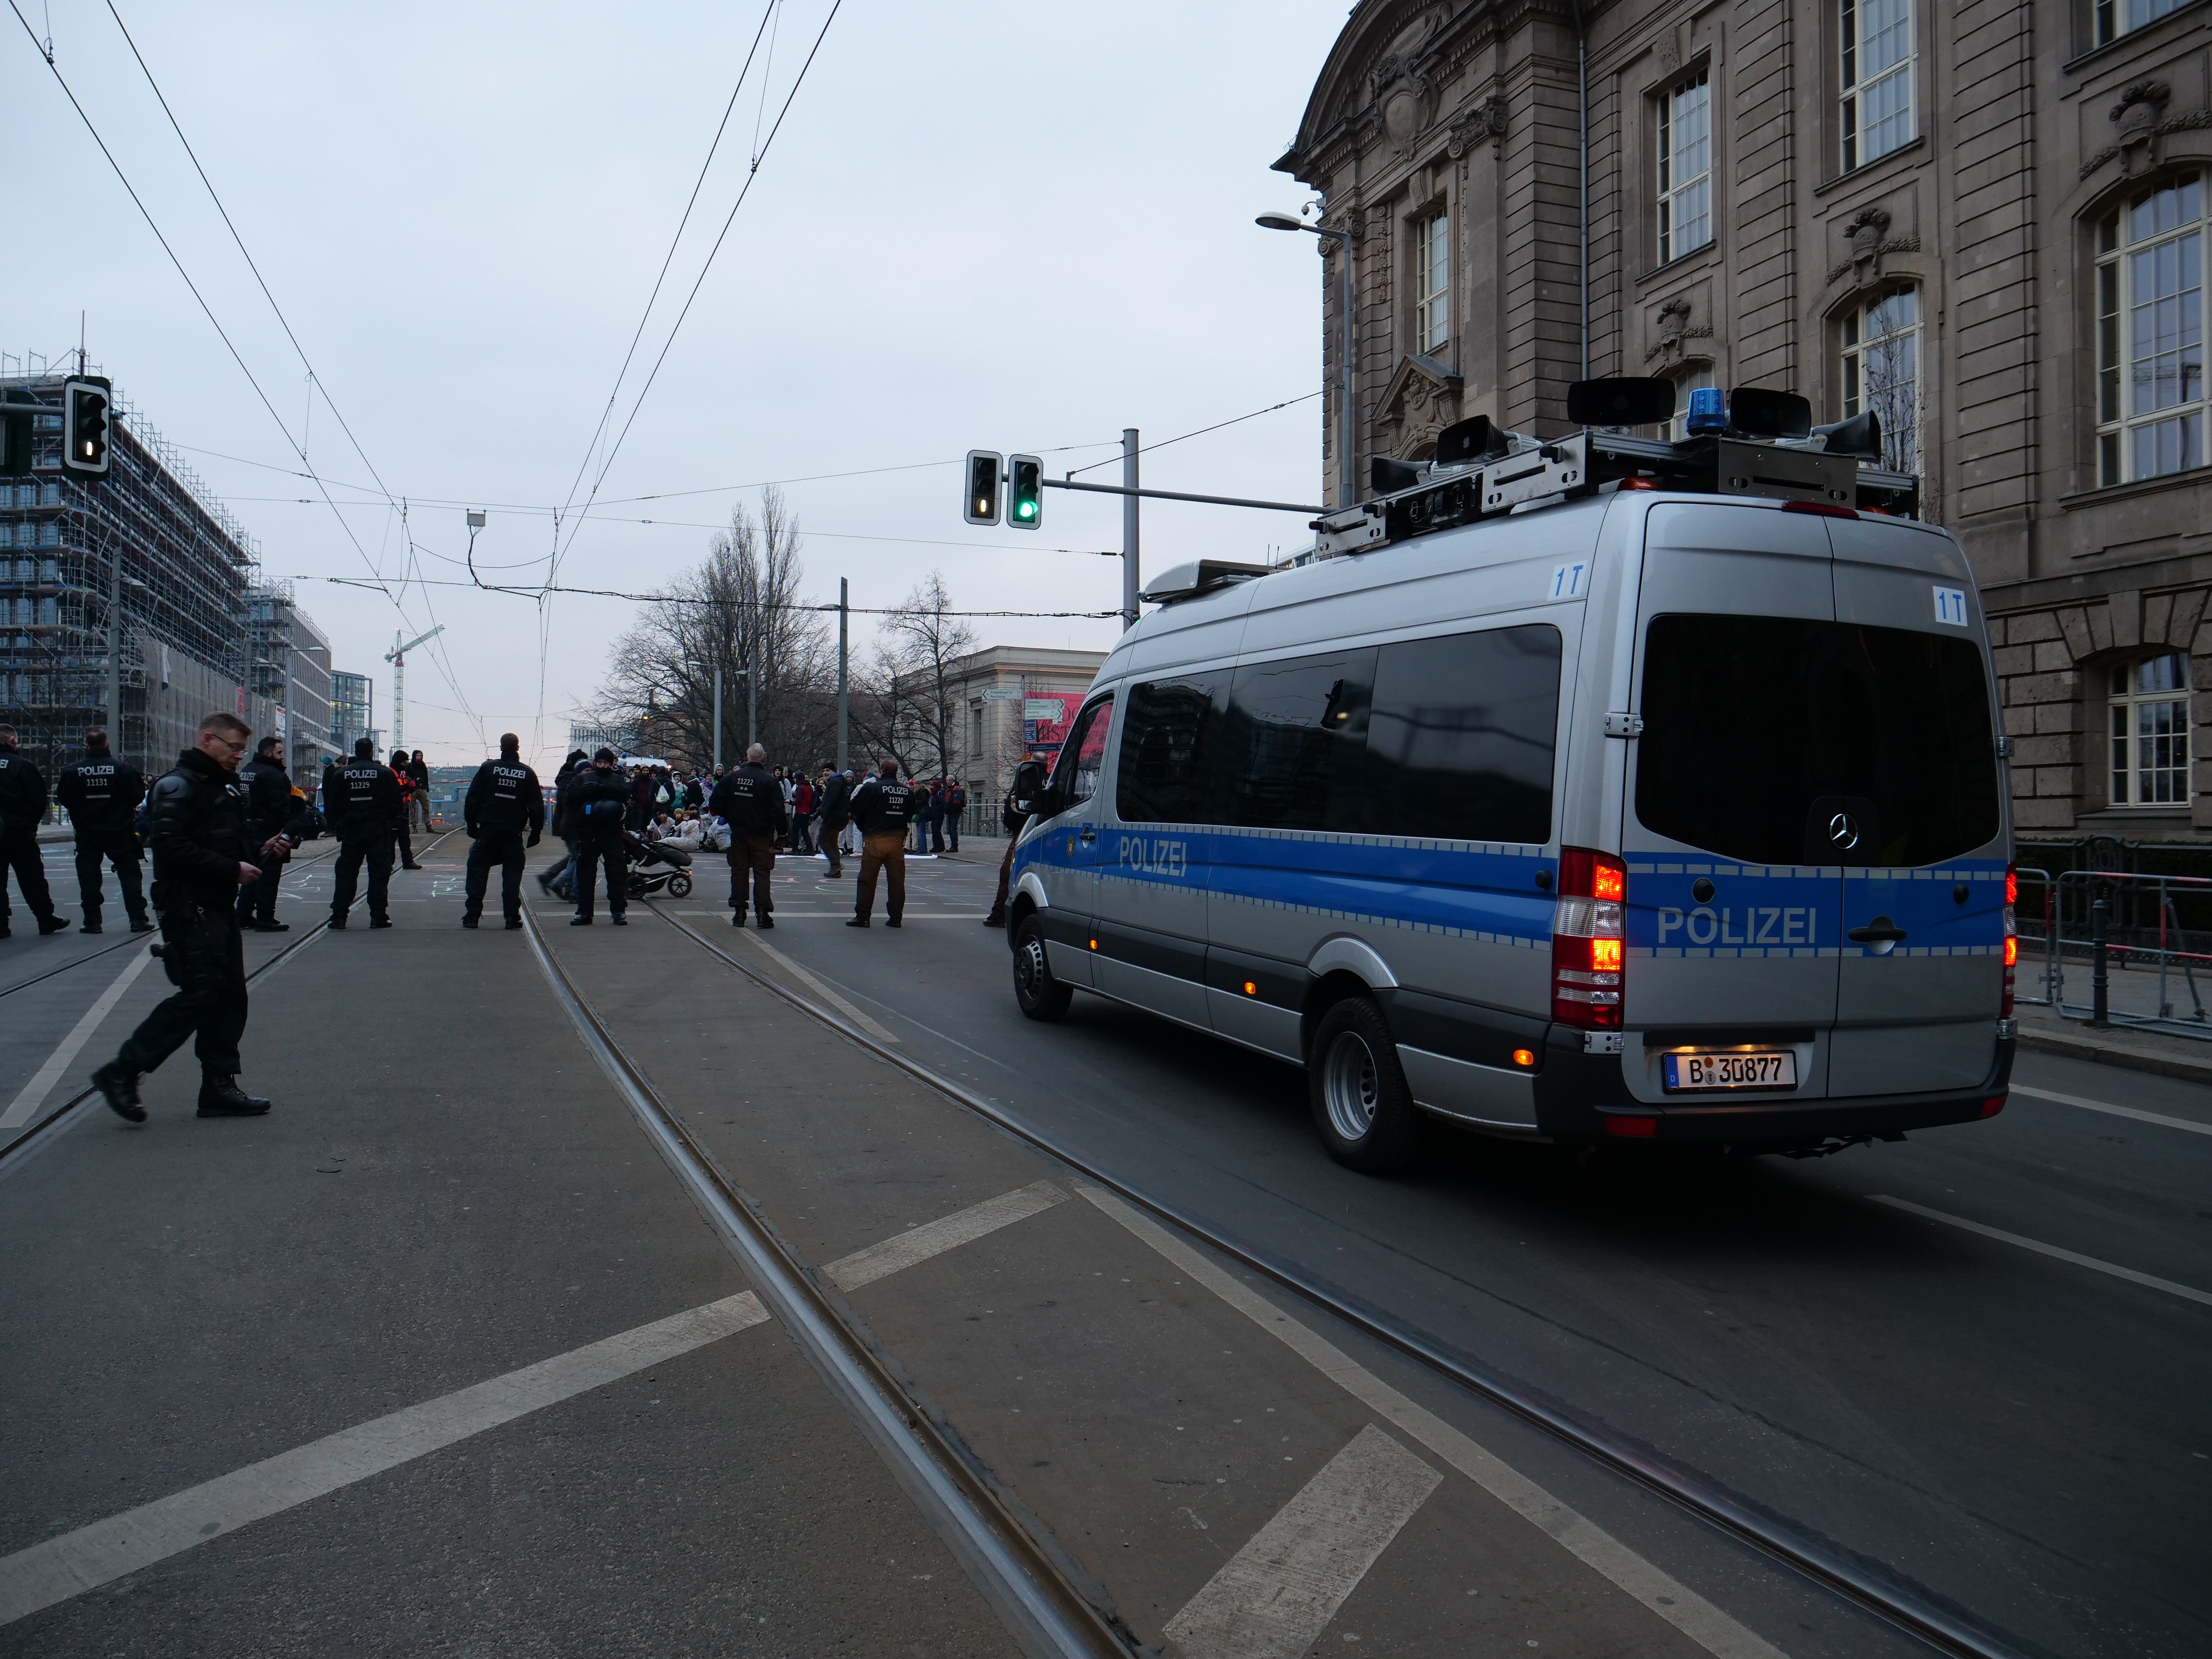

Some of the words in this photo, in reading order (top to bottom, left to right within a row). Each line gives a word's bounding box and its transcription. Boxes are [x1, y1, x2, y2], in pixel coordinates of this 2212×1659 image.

[78, 765, 114, 776] POLIZEI
[344, 770, 377, 779] POLIZEI
[493, 766, 526, 779] POLIZEI
[498, 778, 516, 787] 11232
[737, 777, 754, 786] 11222
[882, 786, 908, 795] POLIZEI
[1120, 836, 1187, 877] POLIZEI
[1658, 907, 1816, 944] POLIZEI
[1689, 1058, 1704, 1083] B
[1718, 1057, 1782, 1083] 30877
